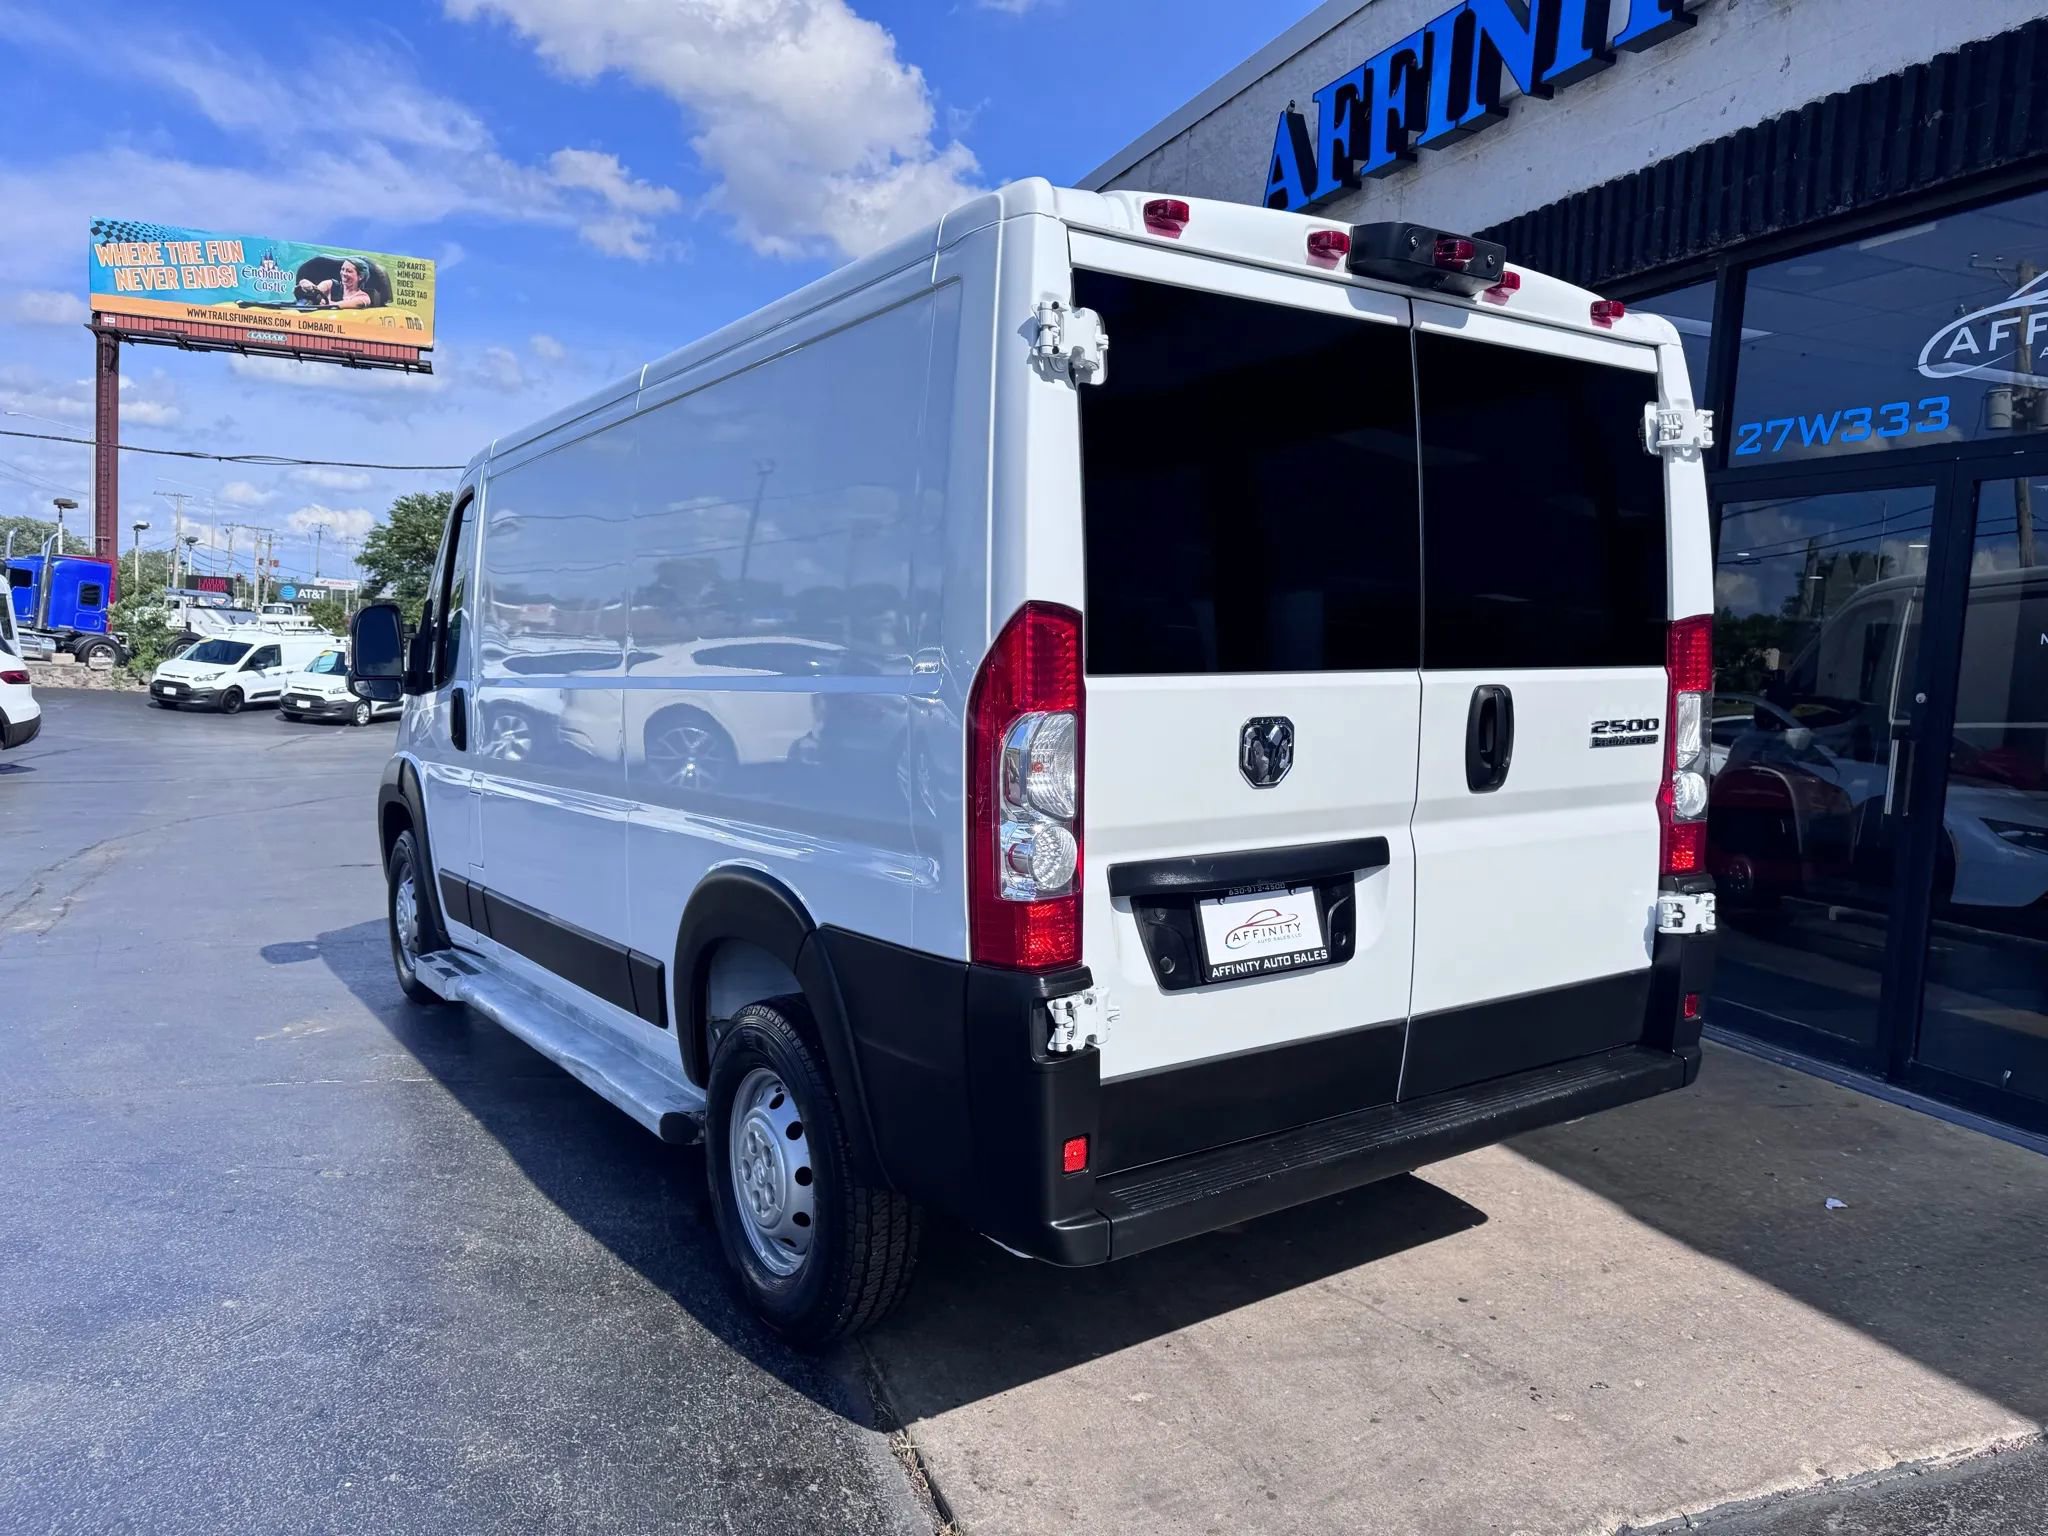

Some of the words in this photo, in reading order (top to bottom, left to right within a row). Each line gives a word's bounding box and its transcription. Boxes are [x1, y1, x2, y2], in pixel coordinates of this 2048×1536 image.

[95, 242, 163, 267] WHERE
[165, 241, 204, 265] THE
[206, 240, 245, 263] FUN
[114, 267, 179, 291] NEVER
[181, 265, 238, 289] ENDS!
[241, 265, 294, 281] Enchanted
[253, 280, 287, 292] Castle
[397, 280, 414, 288] RIDES
[397, 288, 415, 298] LASER
[417, 291, 427, 299] TAG
[397, 298, 417, 307] GAMES
[186, 308, 292, 328] WWW.TRAILSFUNPARKS.COM
[298, 320, 336, 334] LOMBARD,
[250, 333, 284, 342] LAMAR
[1735, 395, 1950, 456] 27W333
[298, 588, 327, 600] AT&T
[1591, 718, 1659, 734] 2500
[1232, 921, 1302, 942] AFFINITY
[1212, 960, 1260, 978] AFFINITY
[1263, 955, 1291, 969] AUTO
[1294, 949, 1328, 963] SALES
